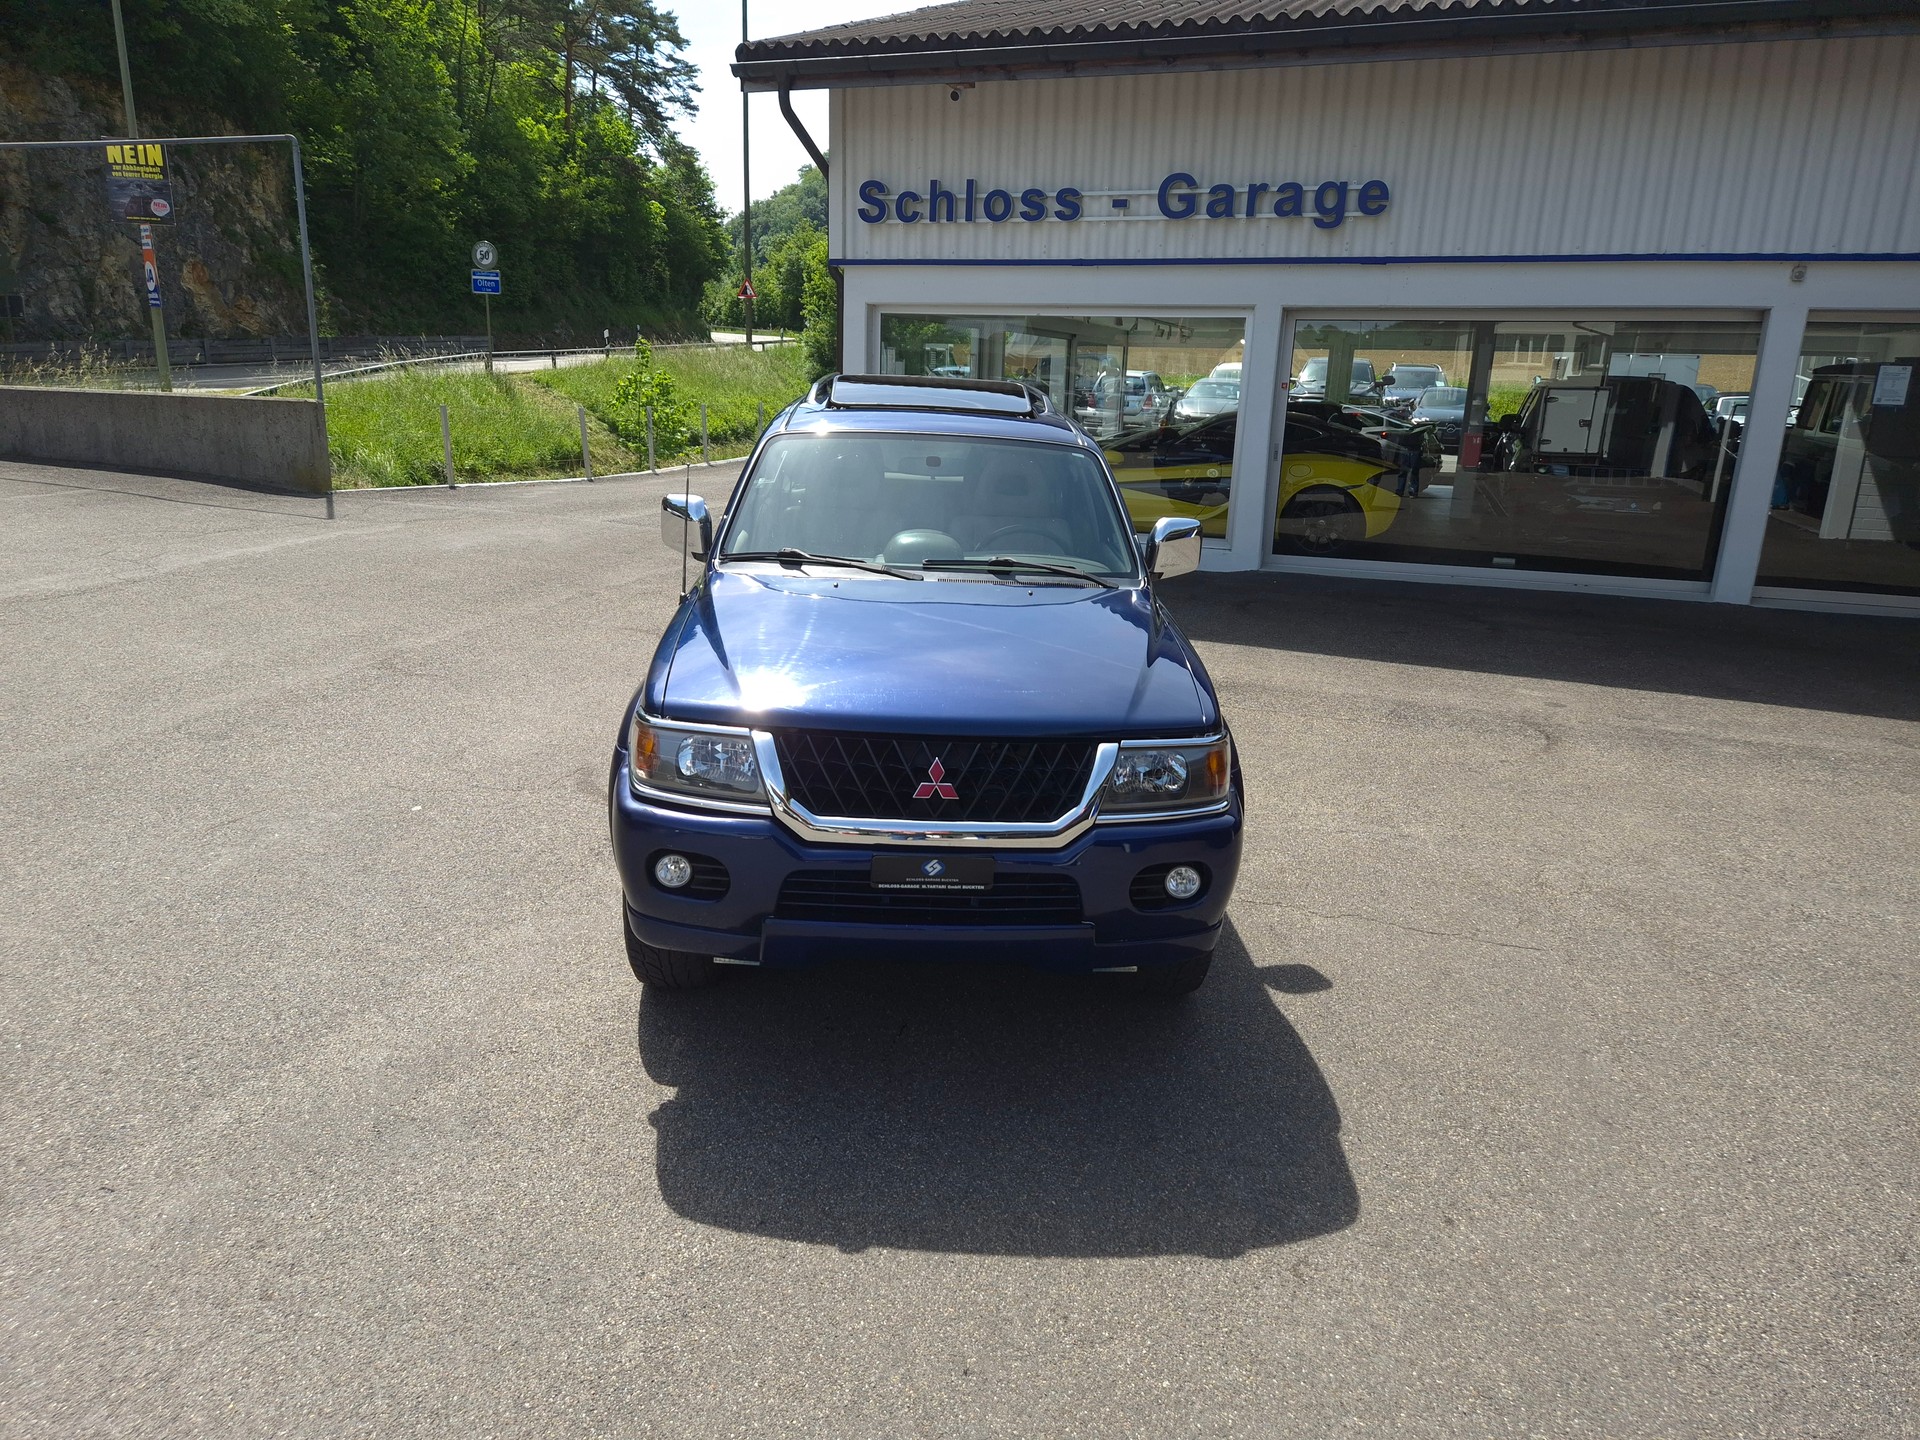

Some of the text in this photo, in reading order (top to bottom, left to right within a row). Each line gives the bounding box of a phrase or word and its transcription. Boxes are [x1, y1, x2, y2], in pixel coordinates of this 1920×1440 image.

[106, 144, 163, 166] NEIN
[857, 178, 1084, 225] Schloss
[1157, 172, 1391, 229] Garage
[480, 250, 490, 260] 50
